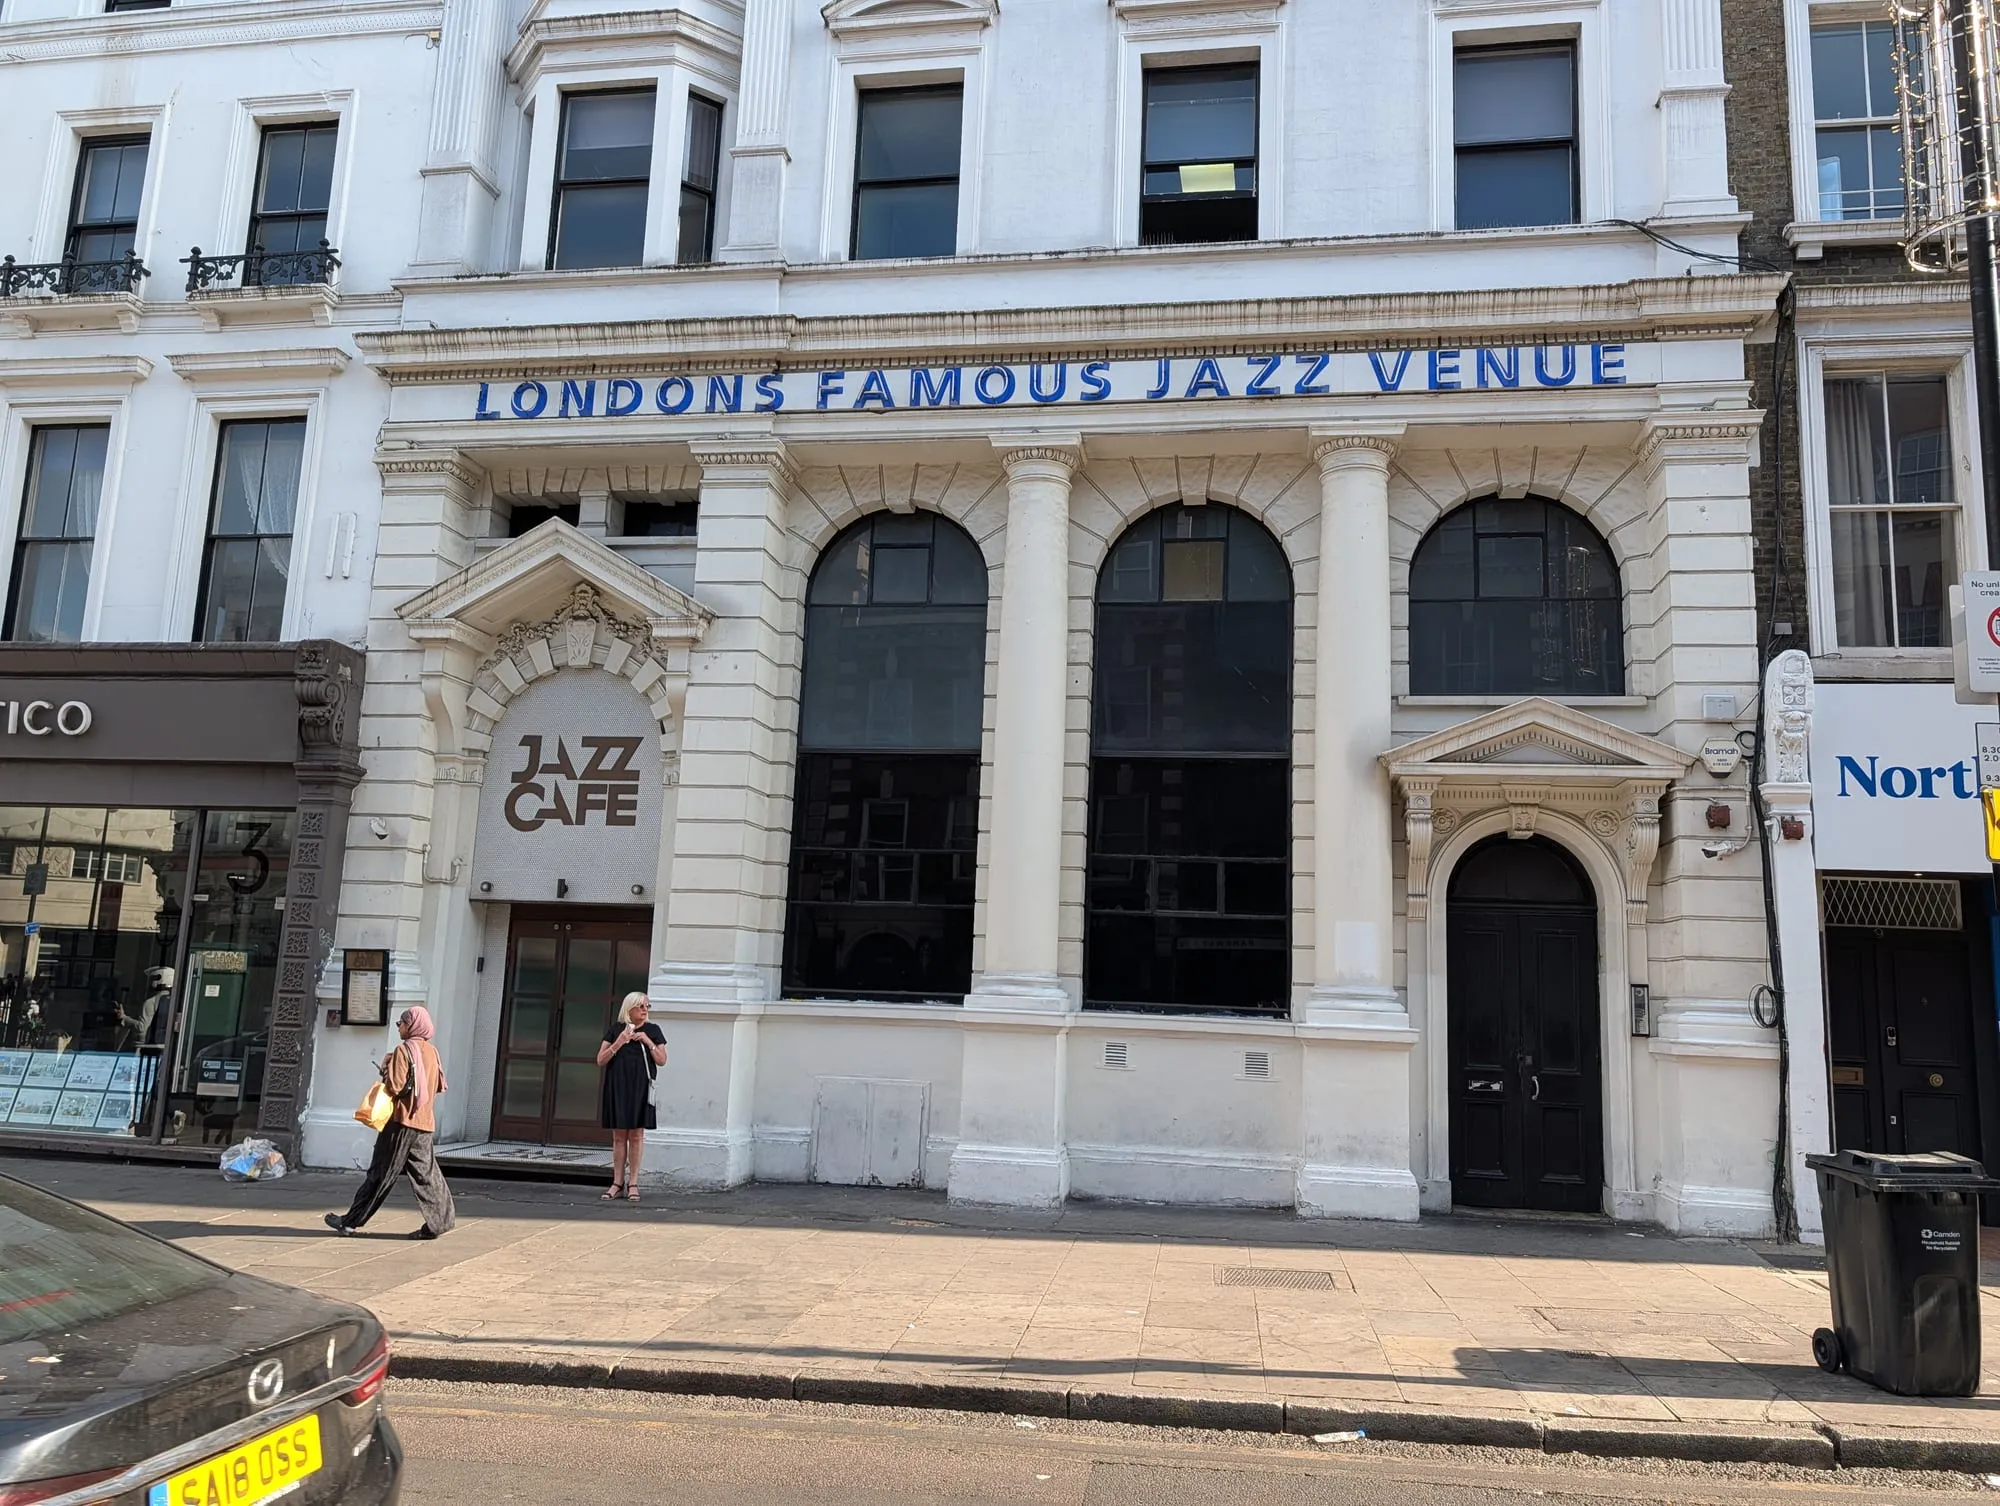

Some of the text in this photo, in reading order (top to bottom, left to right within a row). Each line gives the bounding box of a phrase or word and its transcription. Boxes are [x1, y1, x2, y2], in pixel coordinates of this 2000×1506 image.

[475, 343, 1627, 420] LONDONS FAMOUS JAZZ VENUE
[1971, 580, 1984, 588] No
[511, 735, 644, 783] JAZZ
[1705, 747, 1739, 755] Bramah
[504, 779, 639, 832] CAFE
[227, 822, 272, 894] 3
[259, 1428, 307, 1486] OSS
